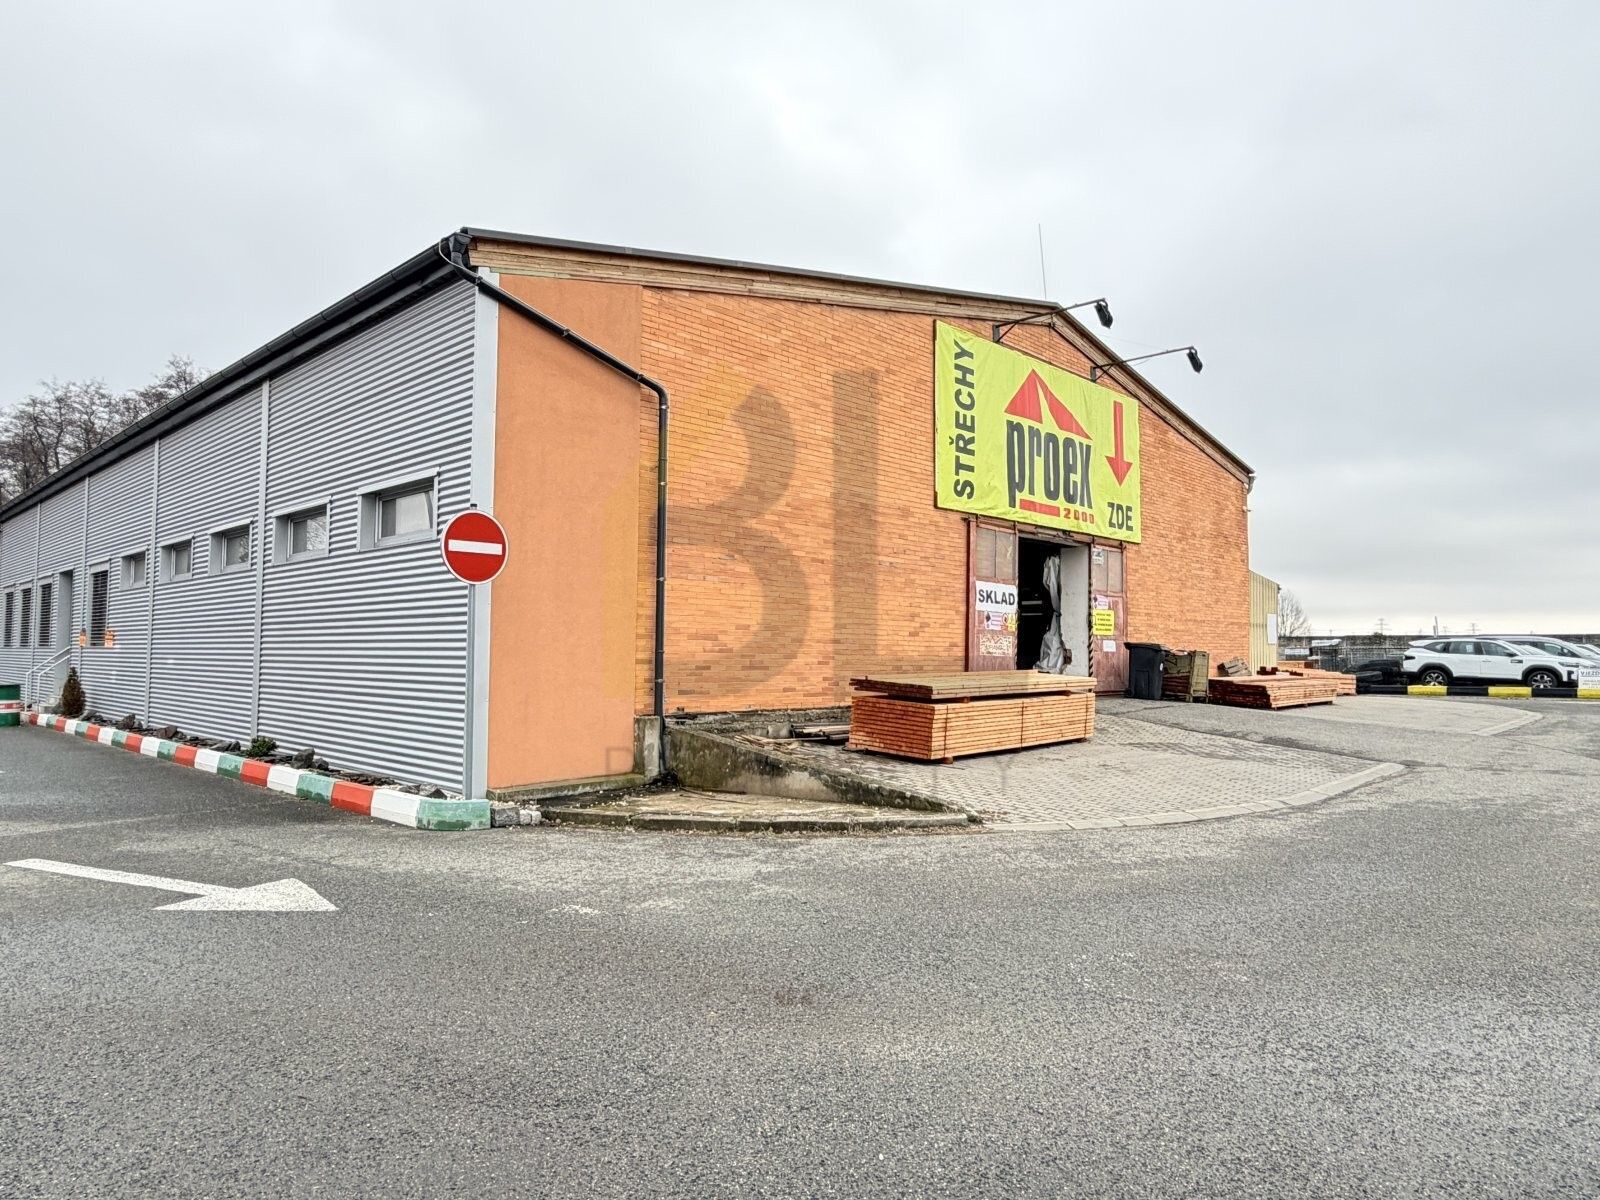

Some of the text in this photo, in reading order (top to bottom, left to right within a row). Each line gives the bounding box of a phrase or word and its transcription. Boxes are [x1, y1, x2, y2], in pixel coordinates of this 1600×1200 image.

[949, 339, 976, 500] STŘECHY
[1006, 419, 1093, 509] proex
[1063, 507, 1095, 525] 2000
[1107, 501, 1134, 532] ZDE
[978, 589, 1016, 606] SKLAD
